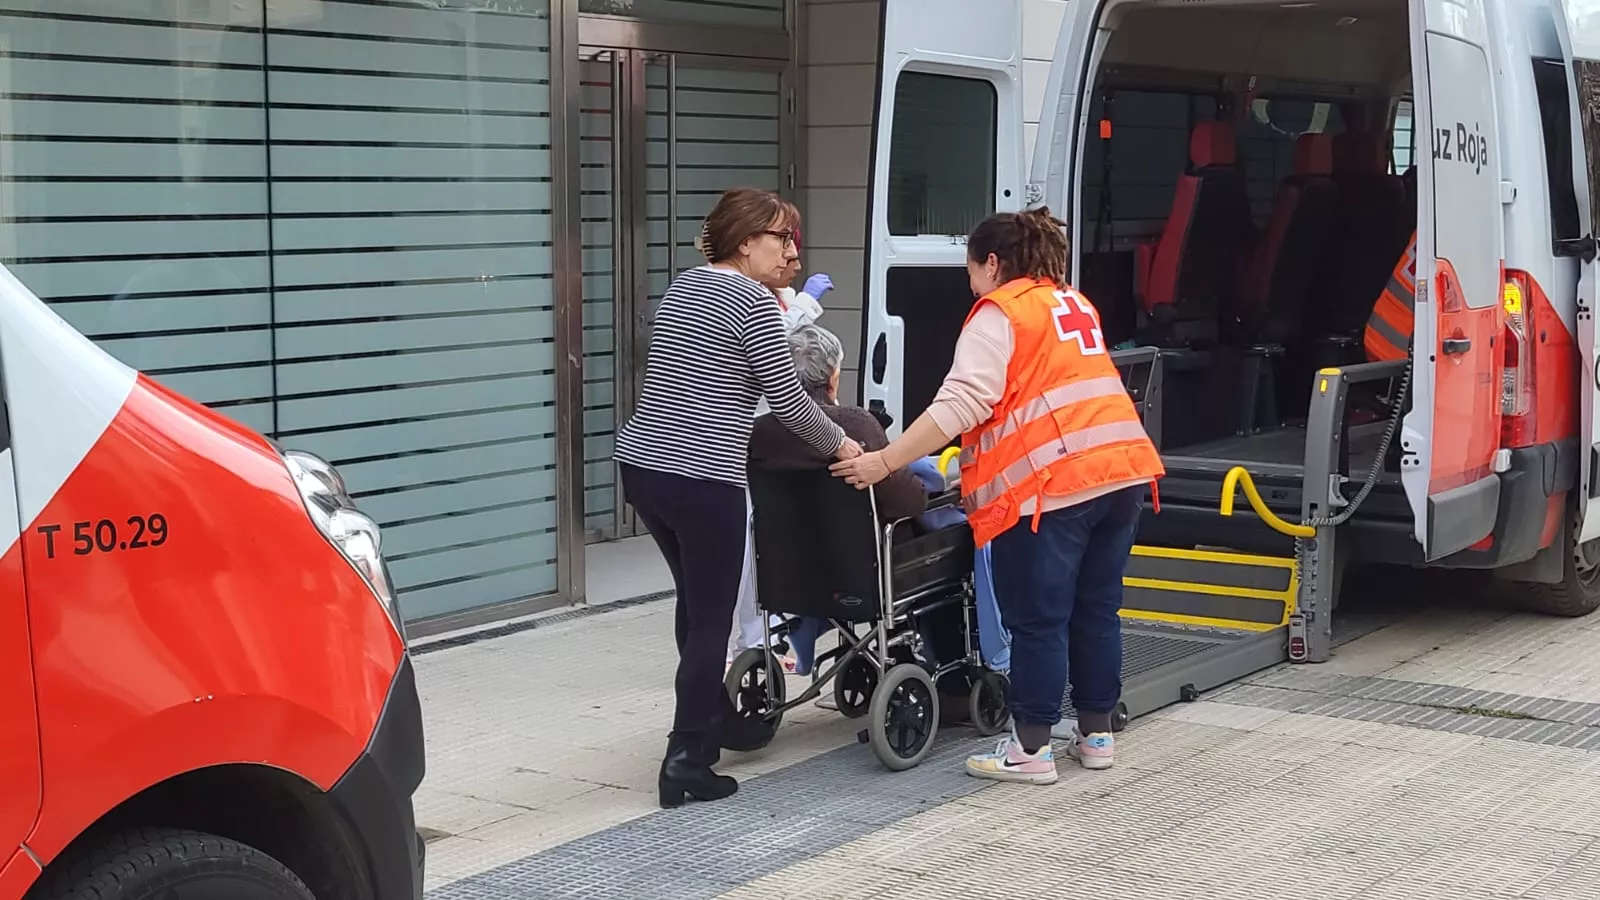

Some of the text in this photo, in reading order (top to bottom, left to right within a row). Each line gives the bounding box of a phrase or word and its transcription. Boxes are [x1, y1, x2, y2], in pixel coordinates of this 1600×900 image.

[1456, 121, 1487, 175] Roja
[37, 513, 168, 559] T 50.29
